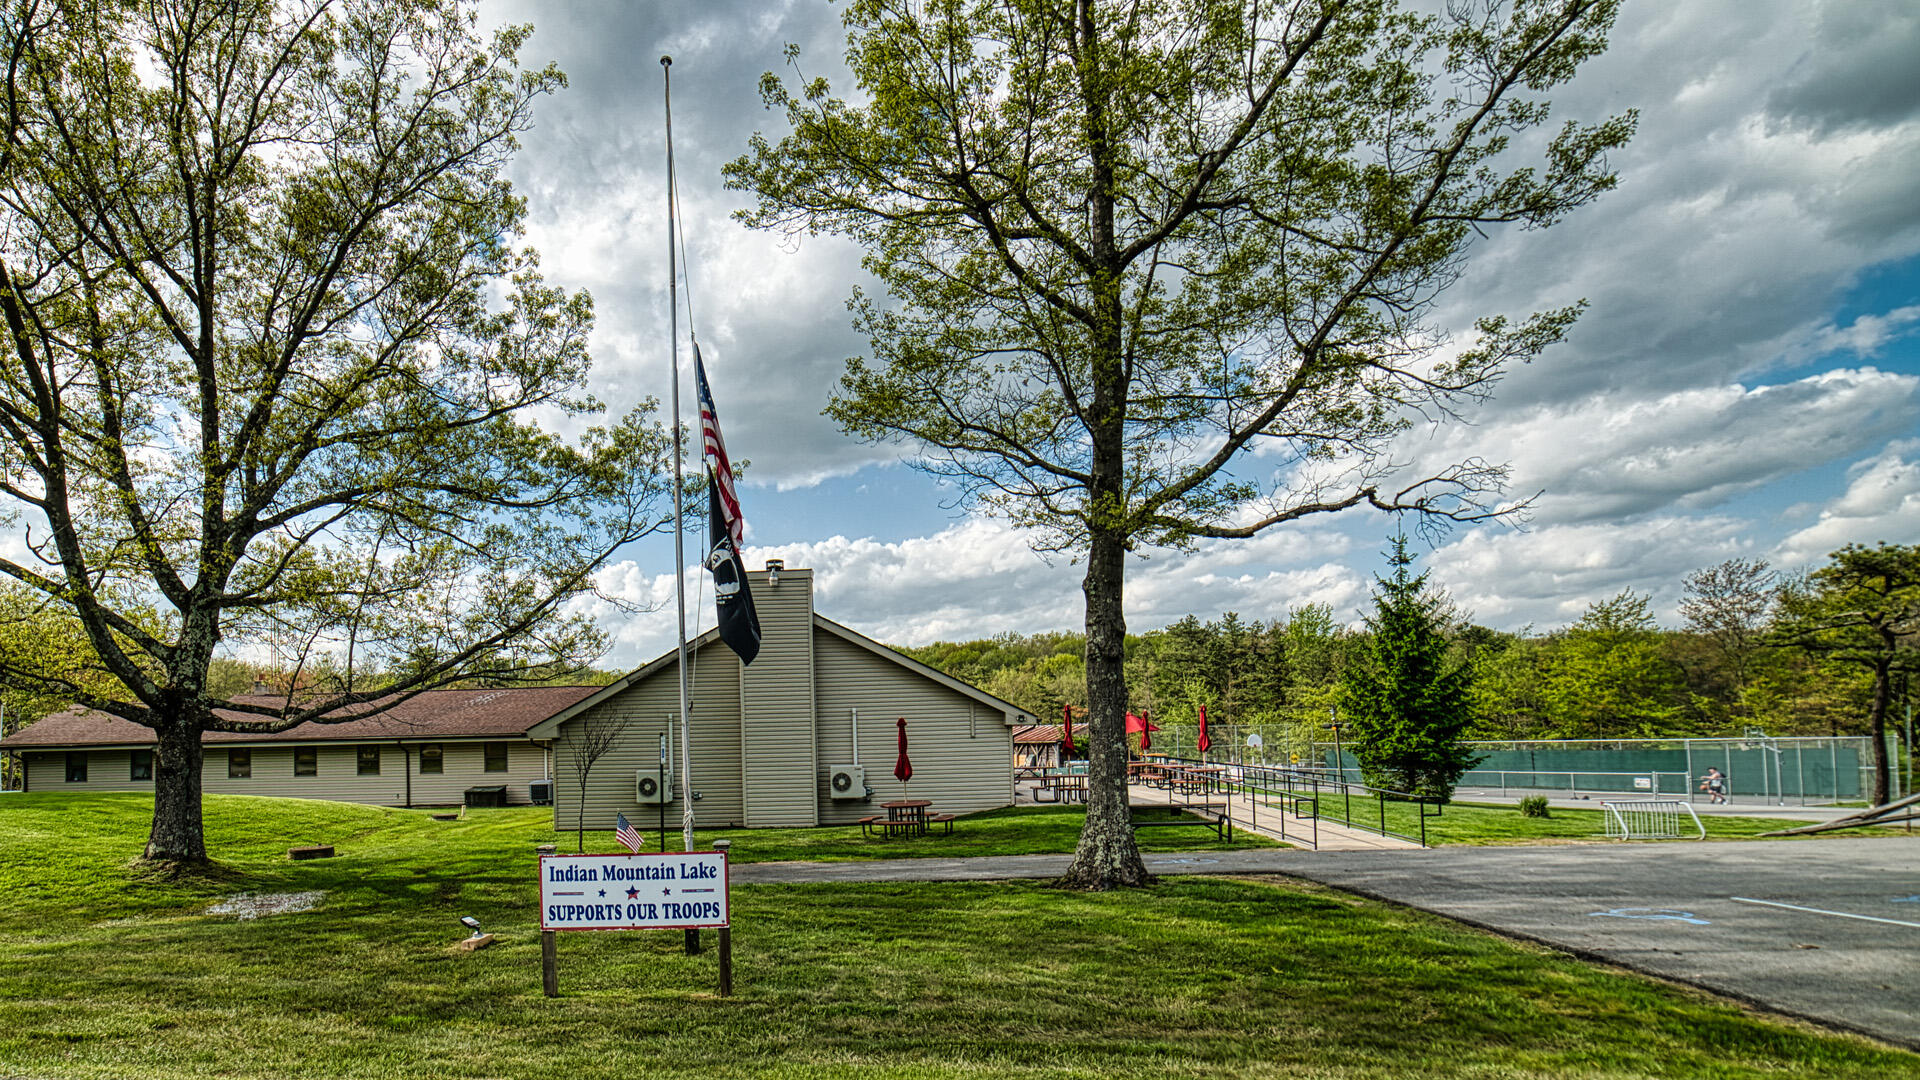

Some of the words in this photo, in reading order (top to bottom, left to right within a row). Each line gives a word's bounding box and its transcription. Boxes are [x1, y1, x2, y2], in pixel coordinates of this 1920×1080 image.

[549, 865, 598, 882] Indian
[602, 862, 676, 881] Mountain
[680, 862, 717, 880] Lake
[549, 904, 622, 921] SUPPORTS
[626, 903, 658, 920] OUR
[662, 902, 720, 919] TROOPS
